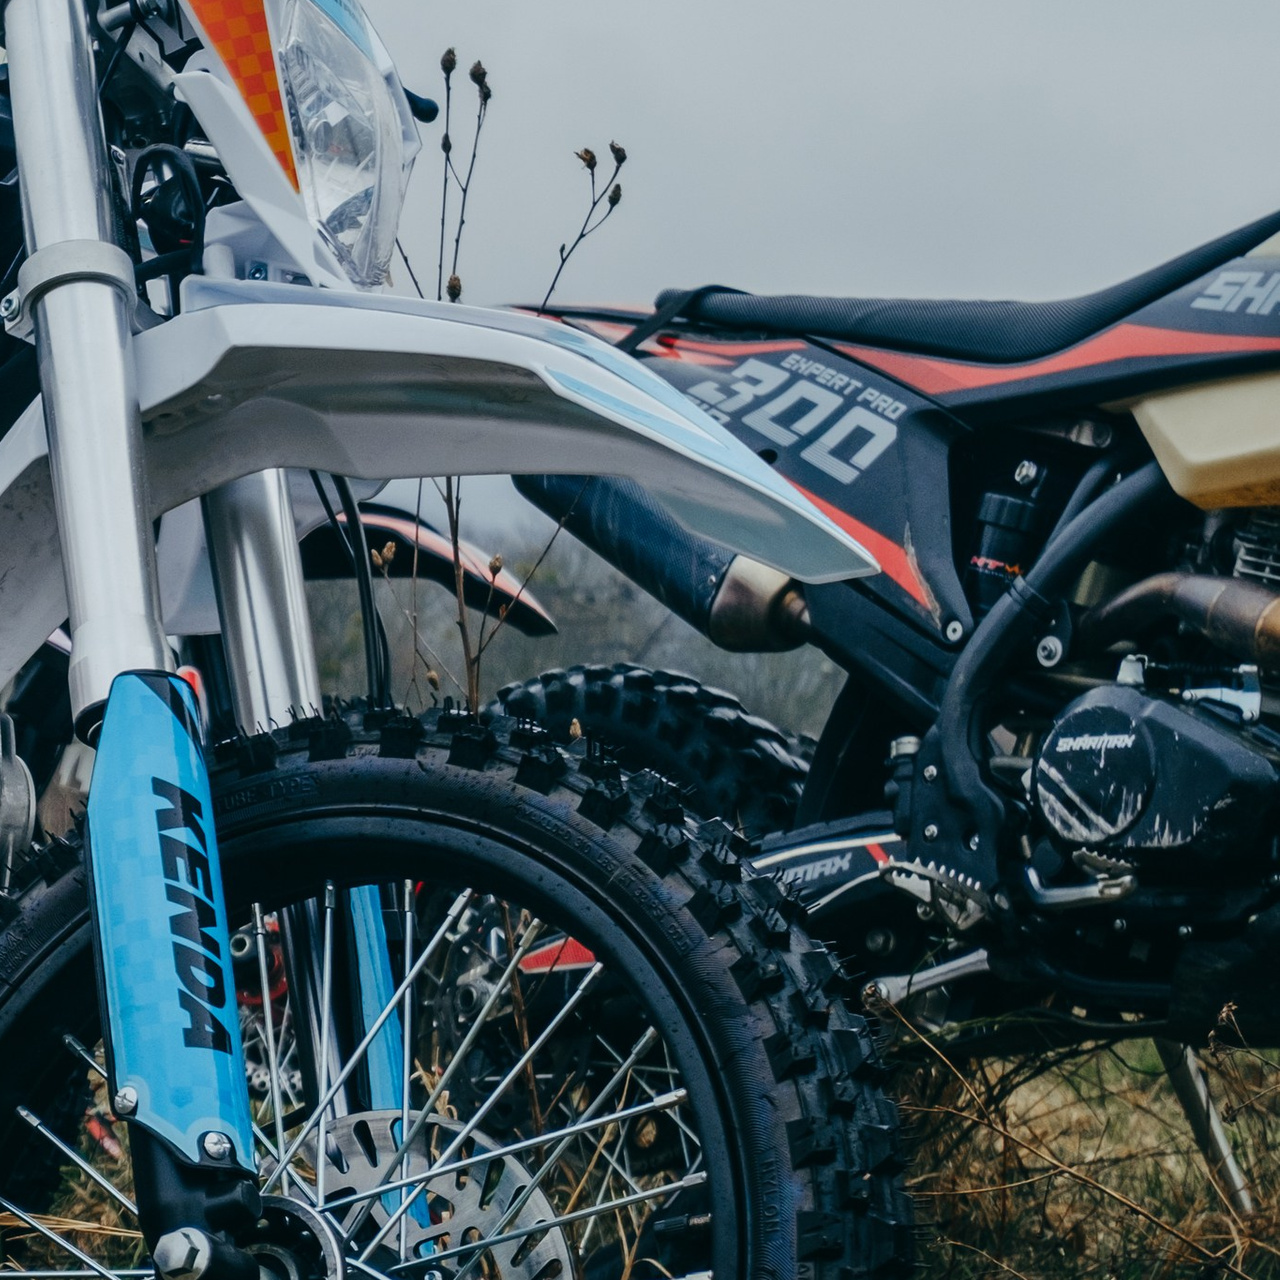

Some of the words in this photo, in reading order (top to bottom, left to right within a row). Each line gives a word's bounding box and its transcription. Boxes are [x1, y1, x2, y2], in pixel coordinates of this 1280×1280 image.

[686, 357, 898, 485] 300
[780, 353, 863, 395] EXPERT
[856, 387, 908, 420] PRO
[151, 776, 233, 1056] KENDA
[758, 1156, 781, 1235] NYLON
